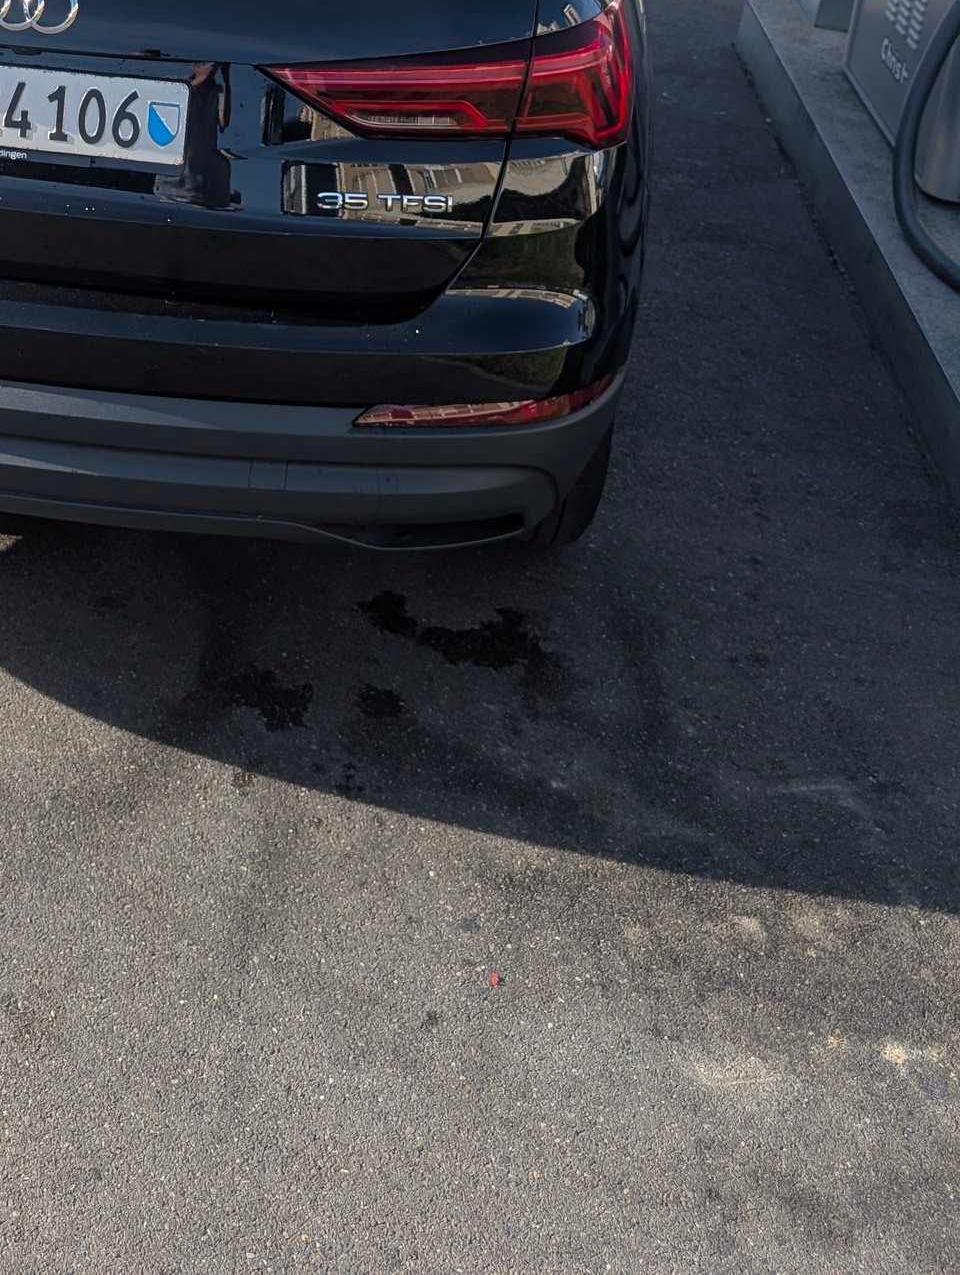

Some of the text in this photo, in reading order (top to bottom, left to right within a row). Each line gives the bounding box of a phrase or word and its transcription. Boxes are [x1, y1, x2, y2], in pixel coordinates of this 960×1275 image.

[881, 38, 908, 84] Christ
[317, 191, 453, 213] 35 TFSI
